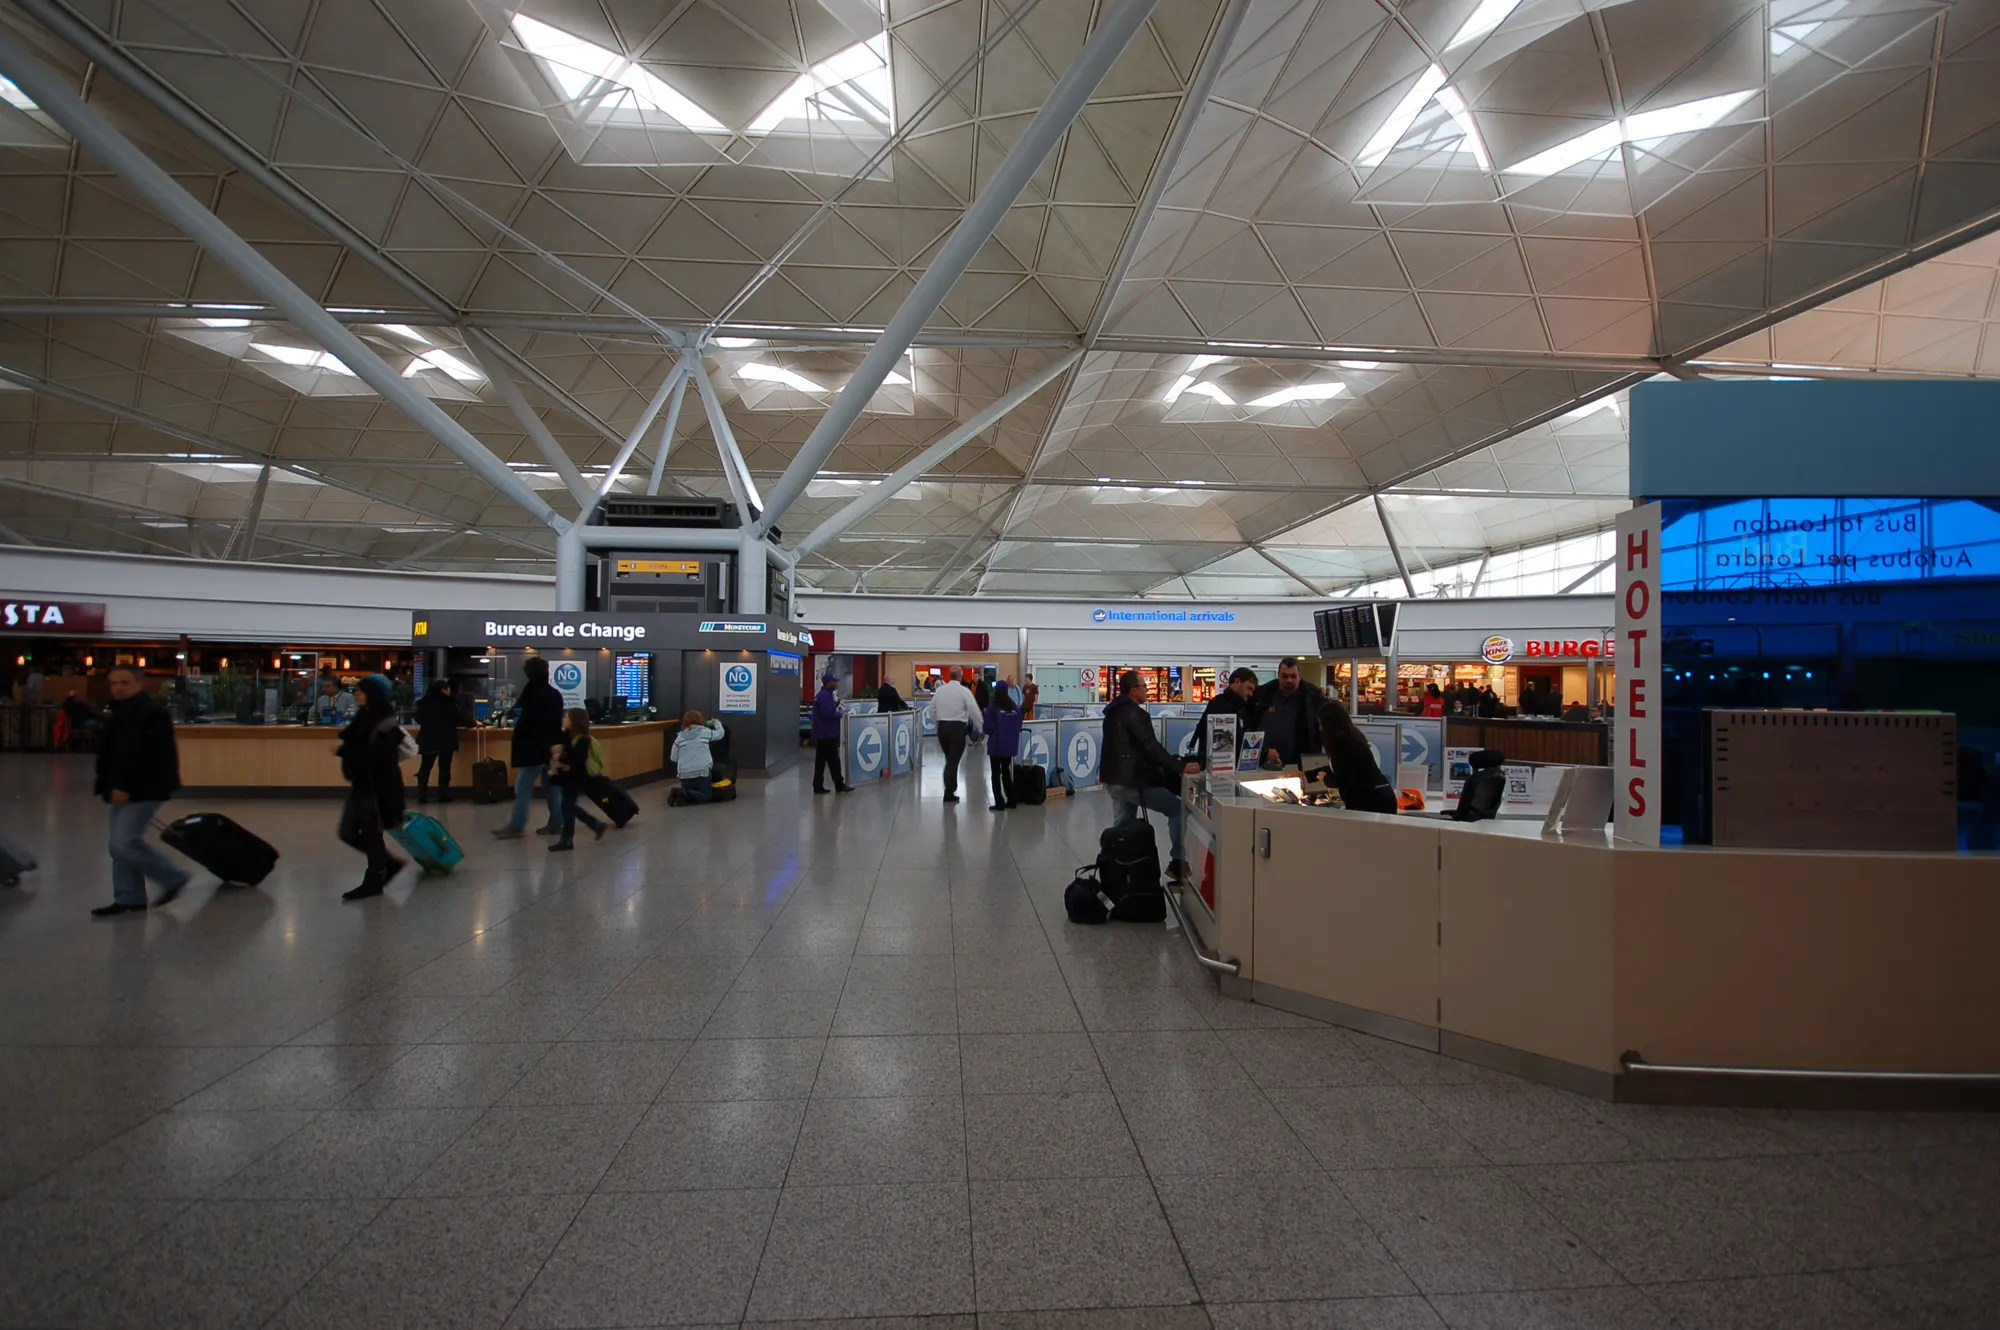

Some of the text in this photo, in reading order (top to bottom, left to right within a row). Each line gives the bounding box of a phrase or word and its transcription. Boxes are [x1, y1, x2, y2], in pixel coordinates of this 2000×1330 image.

[0, 603, 64, 626] STA
[1108, 610, 1235, 621] International arrivals
[414, 621, 427, 636] ATM
[485, 621, 646, 642] Bureau de Change
[1485, 646, 1509, 657] KING
[557, 669, 578, 681] NO
[729, 671, 749, 683] NO
[1626, 529, 1650, 817] HOTELS
